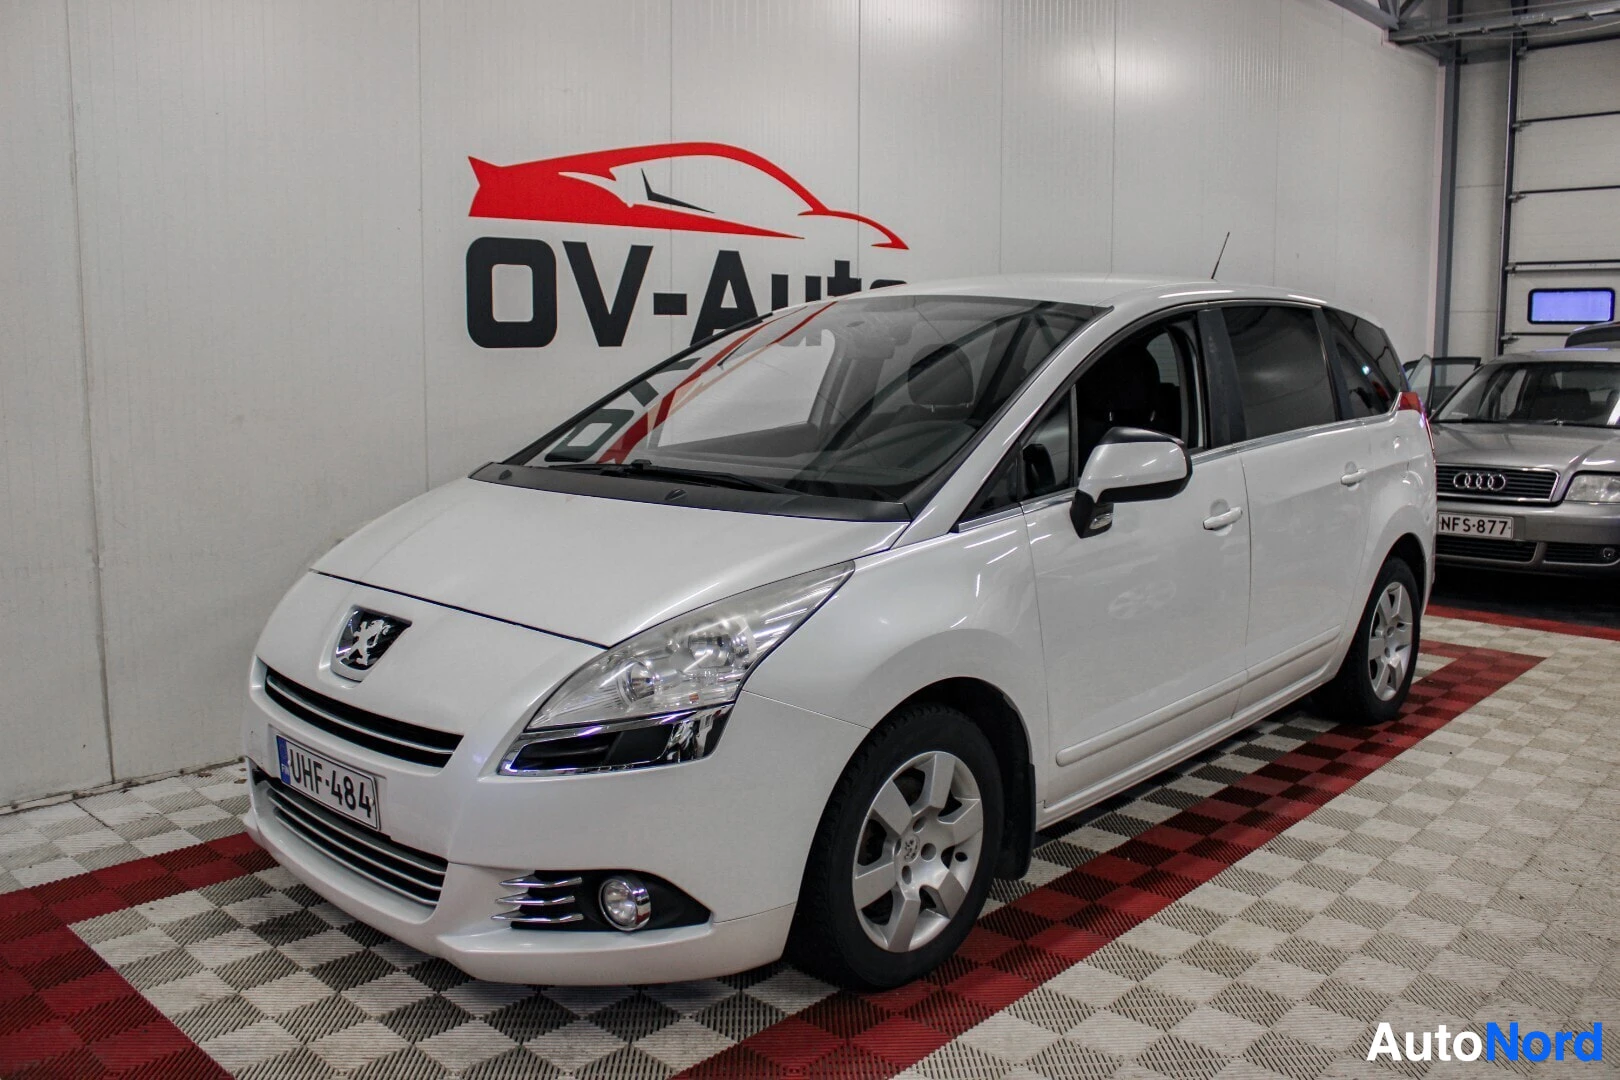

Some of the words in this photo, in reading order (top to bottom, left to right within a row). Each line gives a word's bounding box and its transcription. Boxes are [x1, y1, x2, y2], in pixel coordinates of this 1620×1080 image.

[466, 236, 908, 348] OV-Aut
[1441, 516, 1508, 535] NFS-877
[289, 749, 372, 818] UHF-484
